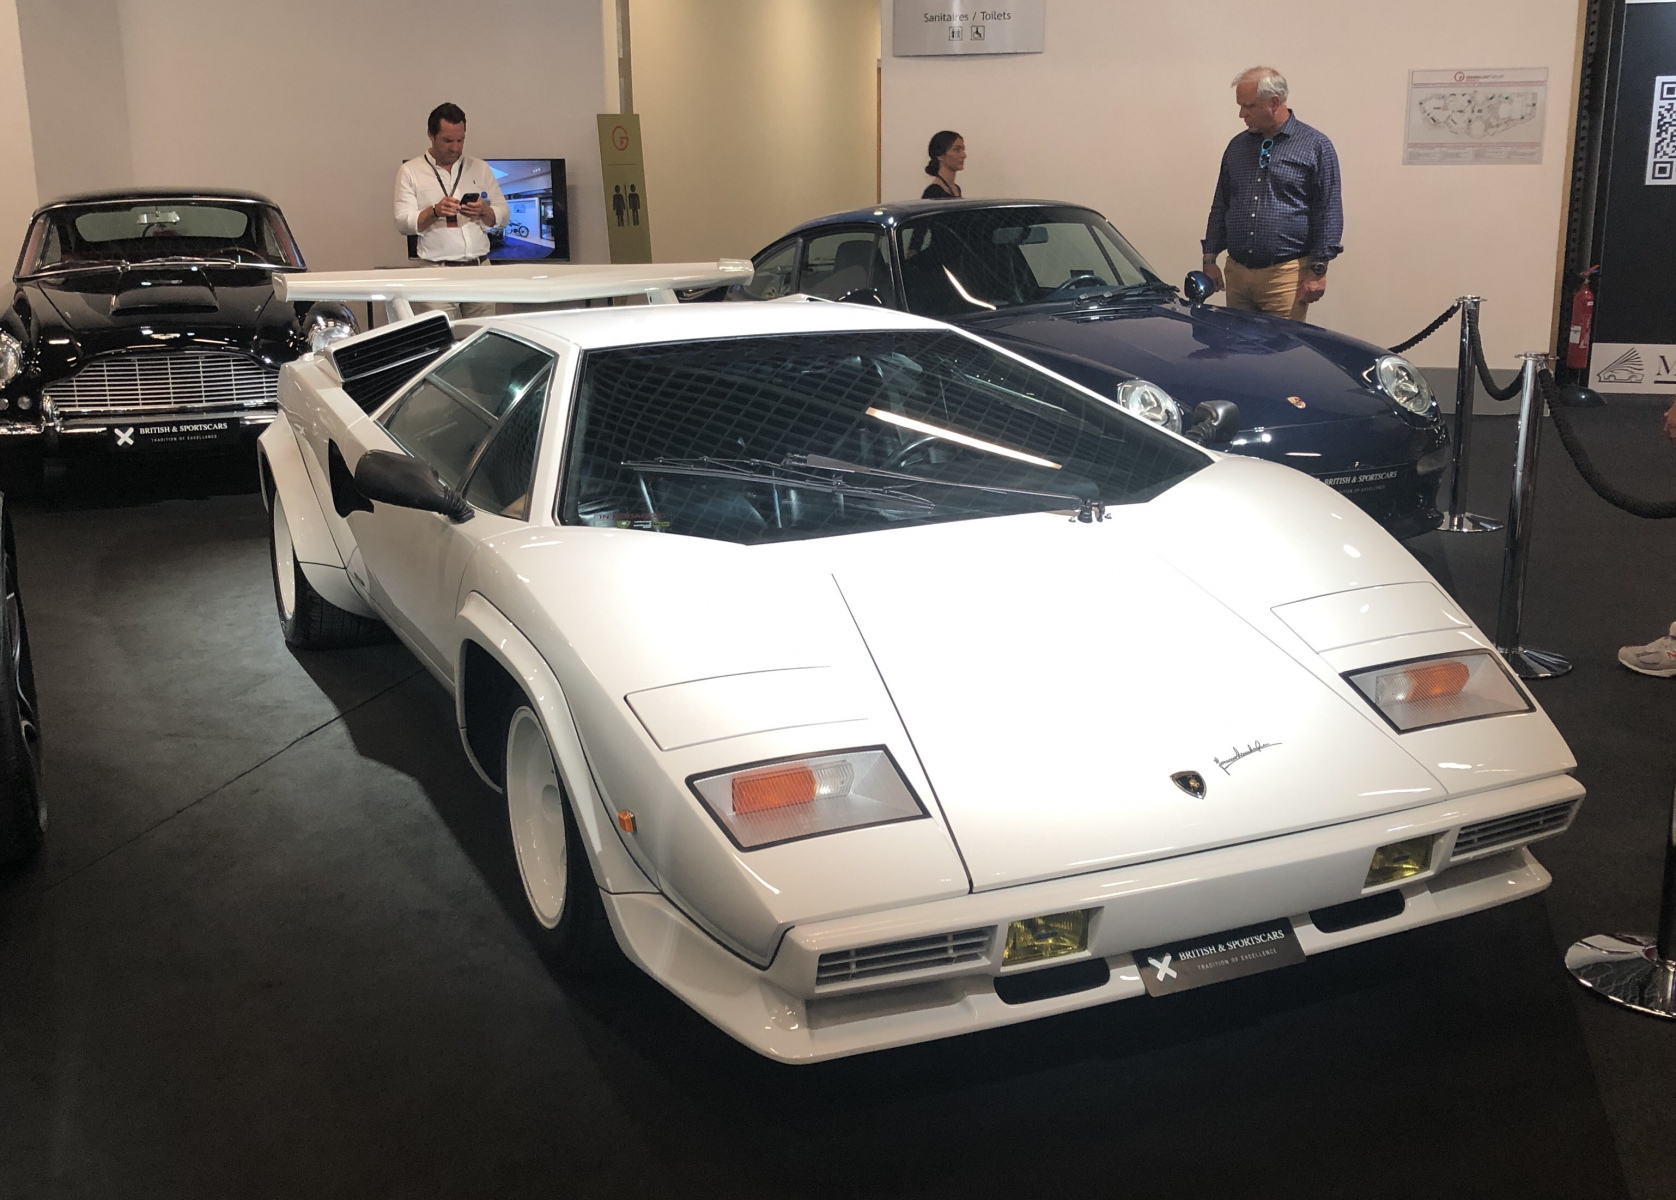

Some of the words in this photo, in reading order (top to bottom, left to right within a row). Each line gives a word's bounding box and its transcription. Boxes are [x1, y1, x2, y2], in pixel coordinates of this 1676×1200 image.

[923, 12, 969, 23] Sanitaires
[980, 10, 1012, 21] Toilets
[139, 425, 170, 435] BRITISH
[171, 424, 179, 433] &
[179, 422, 228, 432] SPORTSCARS
[1324, 477, 1351, 486] BRITISH
[1358, 471, 1398, 483] SPORTSCARS
[1178, 945, 1216, 961] BRITISH
[1218, 943, 1227, 952] &
[1226, 929, 1285, 951] SPORTSCARS
[1197, 958, 1230, 971] TRADITION
[1241, 947, 1278, 962] EXCELLENCE
